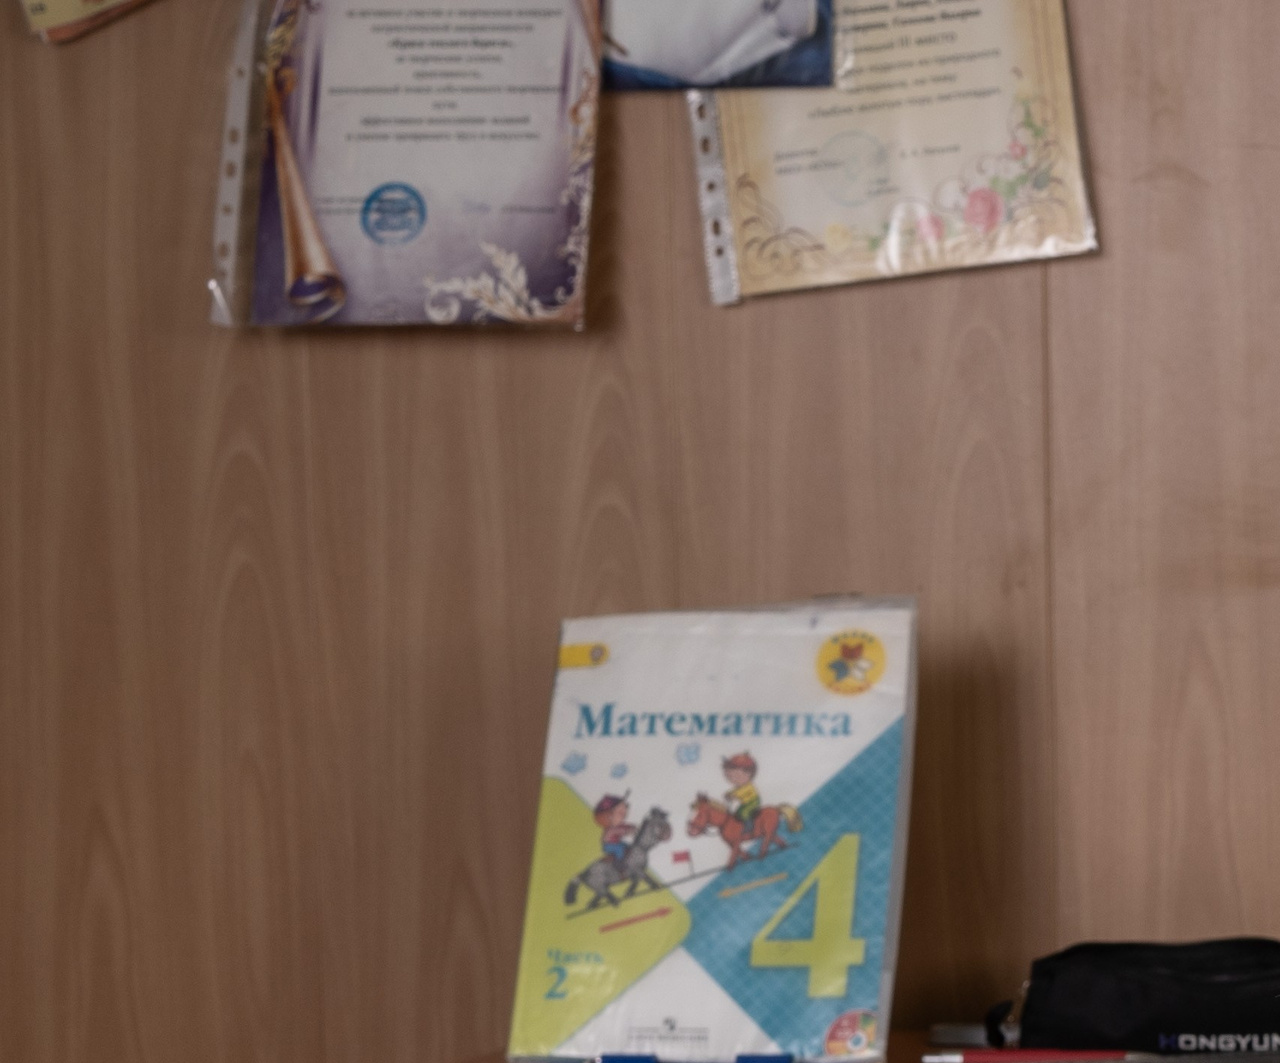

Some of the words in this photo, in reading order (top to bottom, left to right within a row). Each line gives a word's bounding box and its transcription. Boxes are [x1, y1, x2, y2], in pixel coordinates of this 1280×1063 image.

[573, 702, 853, 738] Математика
[750, 832, 866, 998] 4
[544, 965, 568, 1000] 2
